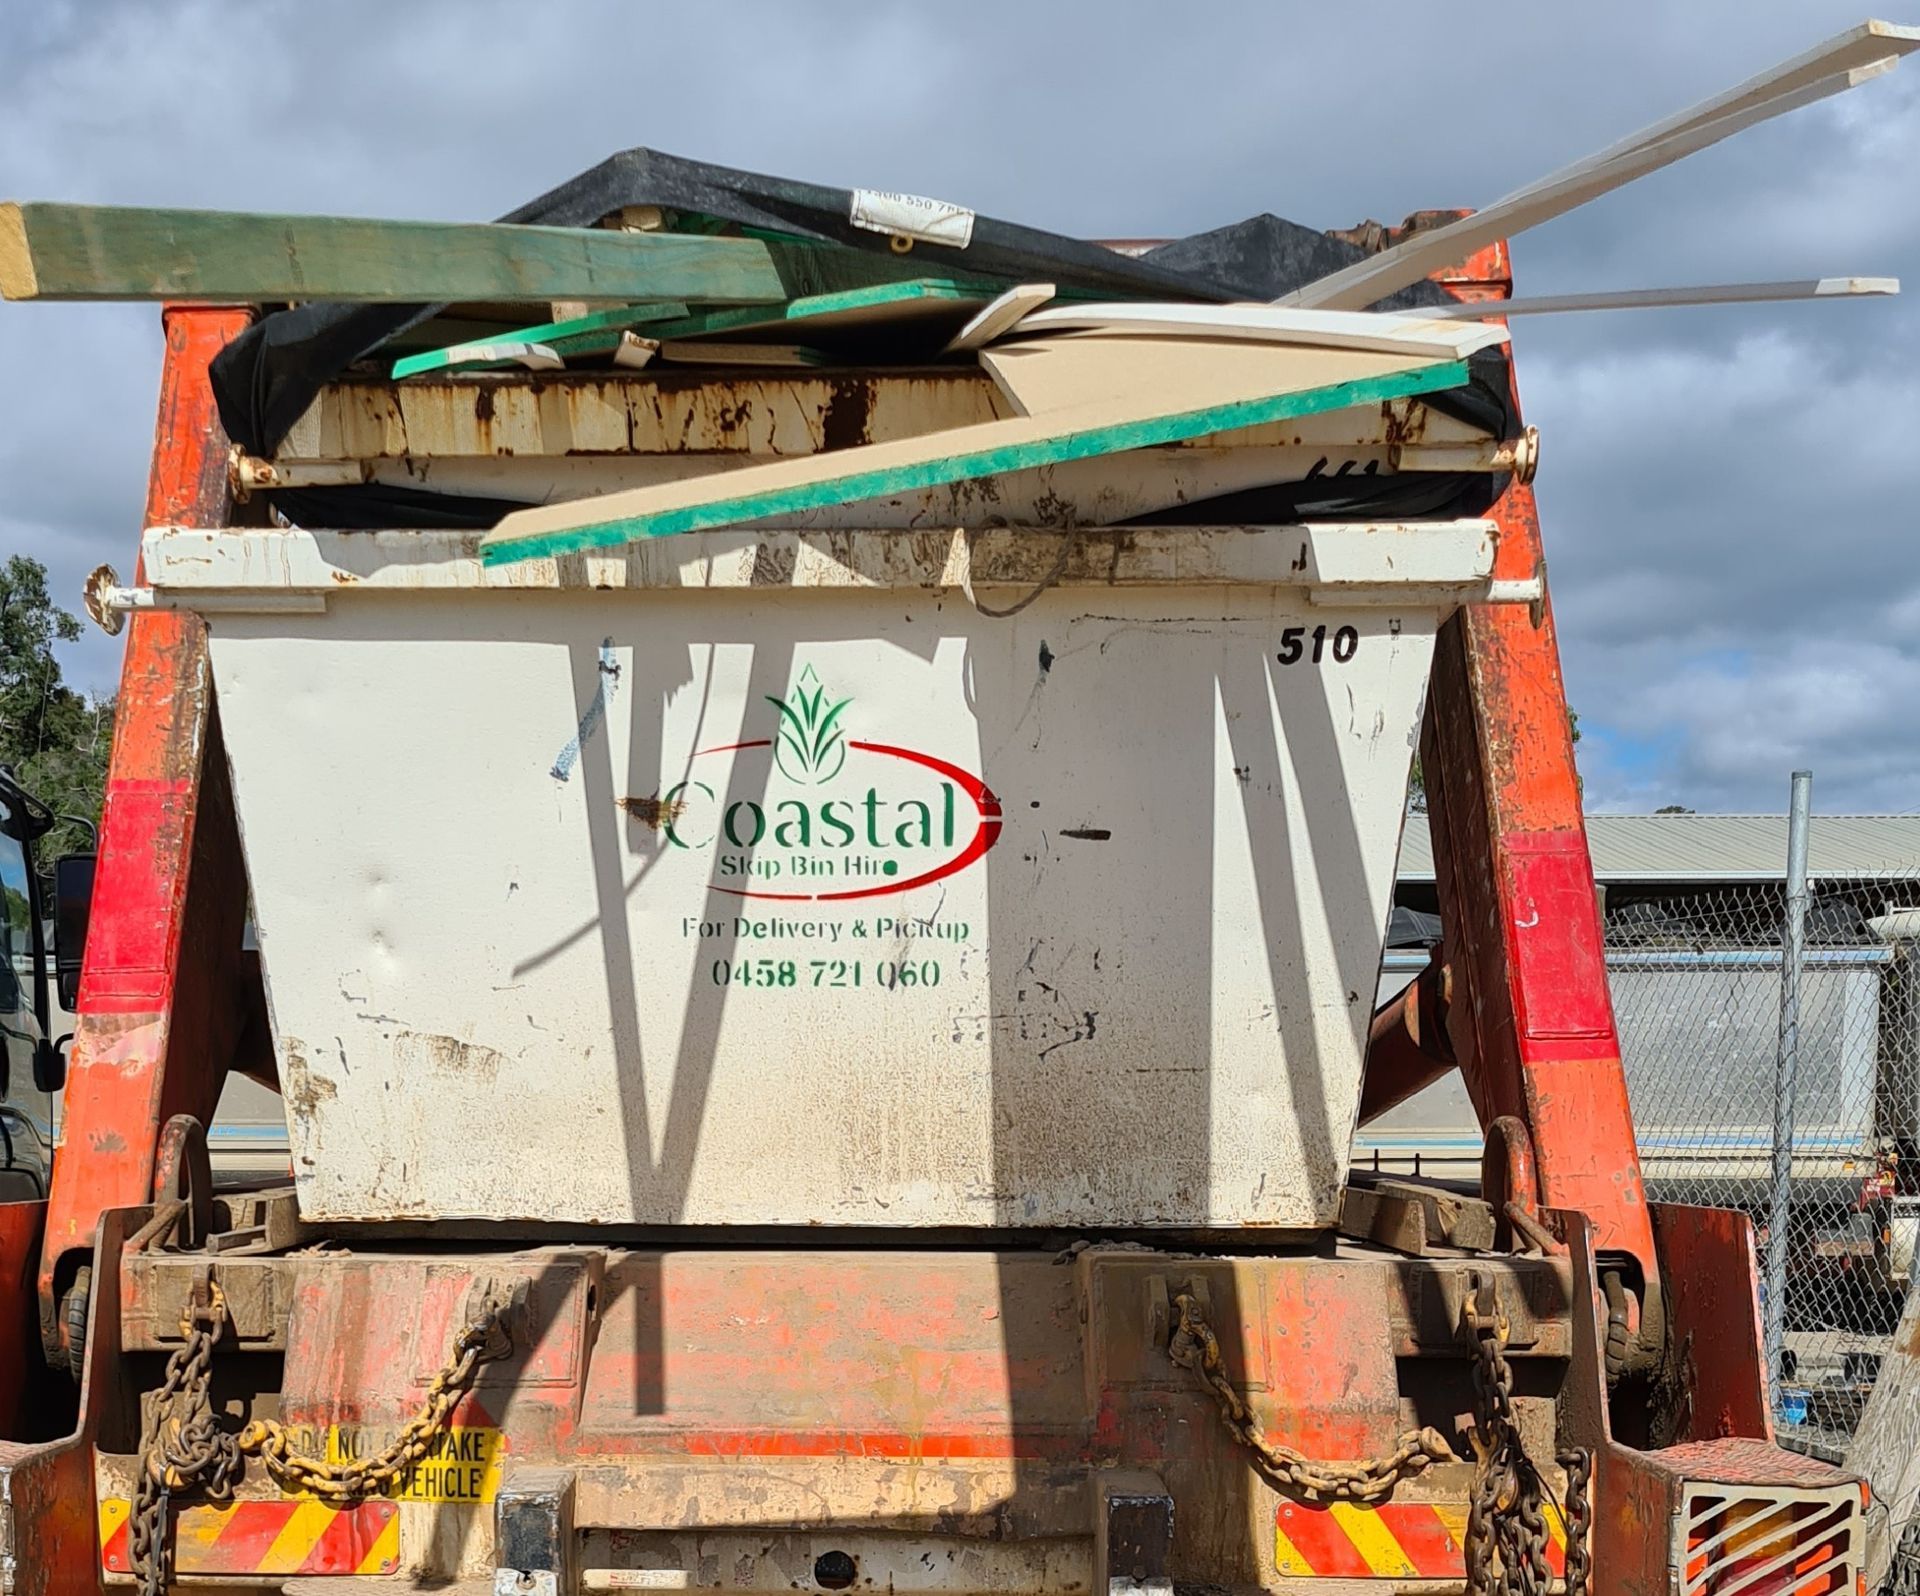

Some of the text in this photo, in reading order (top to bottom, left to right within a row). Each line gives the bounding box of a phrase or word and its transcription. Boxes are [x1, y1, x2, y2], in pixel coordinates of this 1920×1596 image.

[1277, 625, 1358, 665] 510
[663, 781, 954, 849] Coastal
[721, 856, 780, 879] Skip
[791, 856, 834, 876] Bin
[683, 917, 969, 943] For Delivery & Pickup
[713, 960, 940, 990] 0458 721 060
[400, 1466, 481, 1498] VEHICLE
